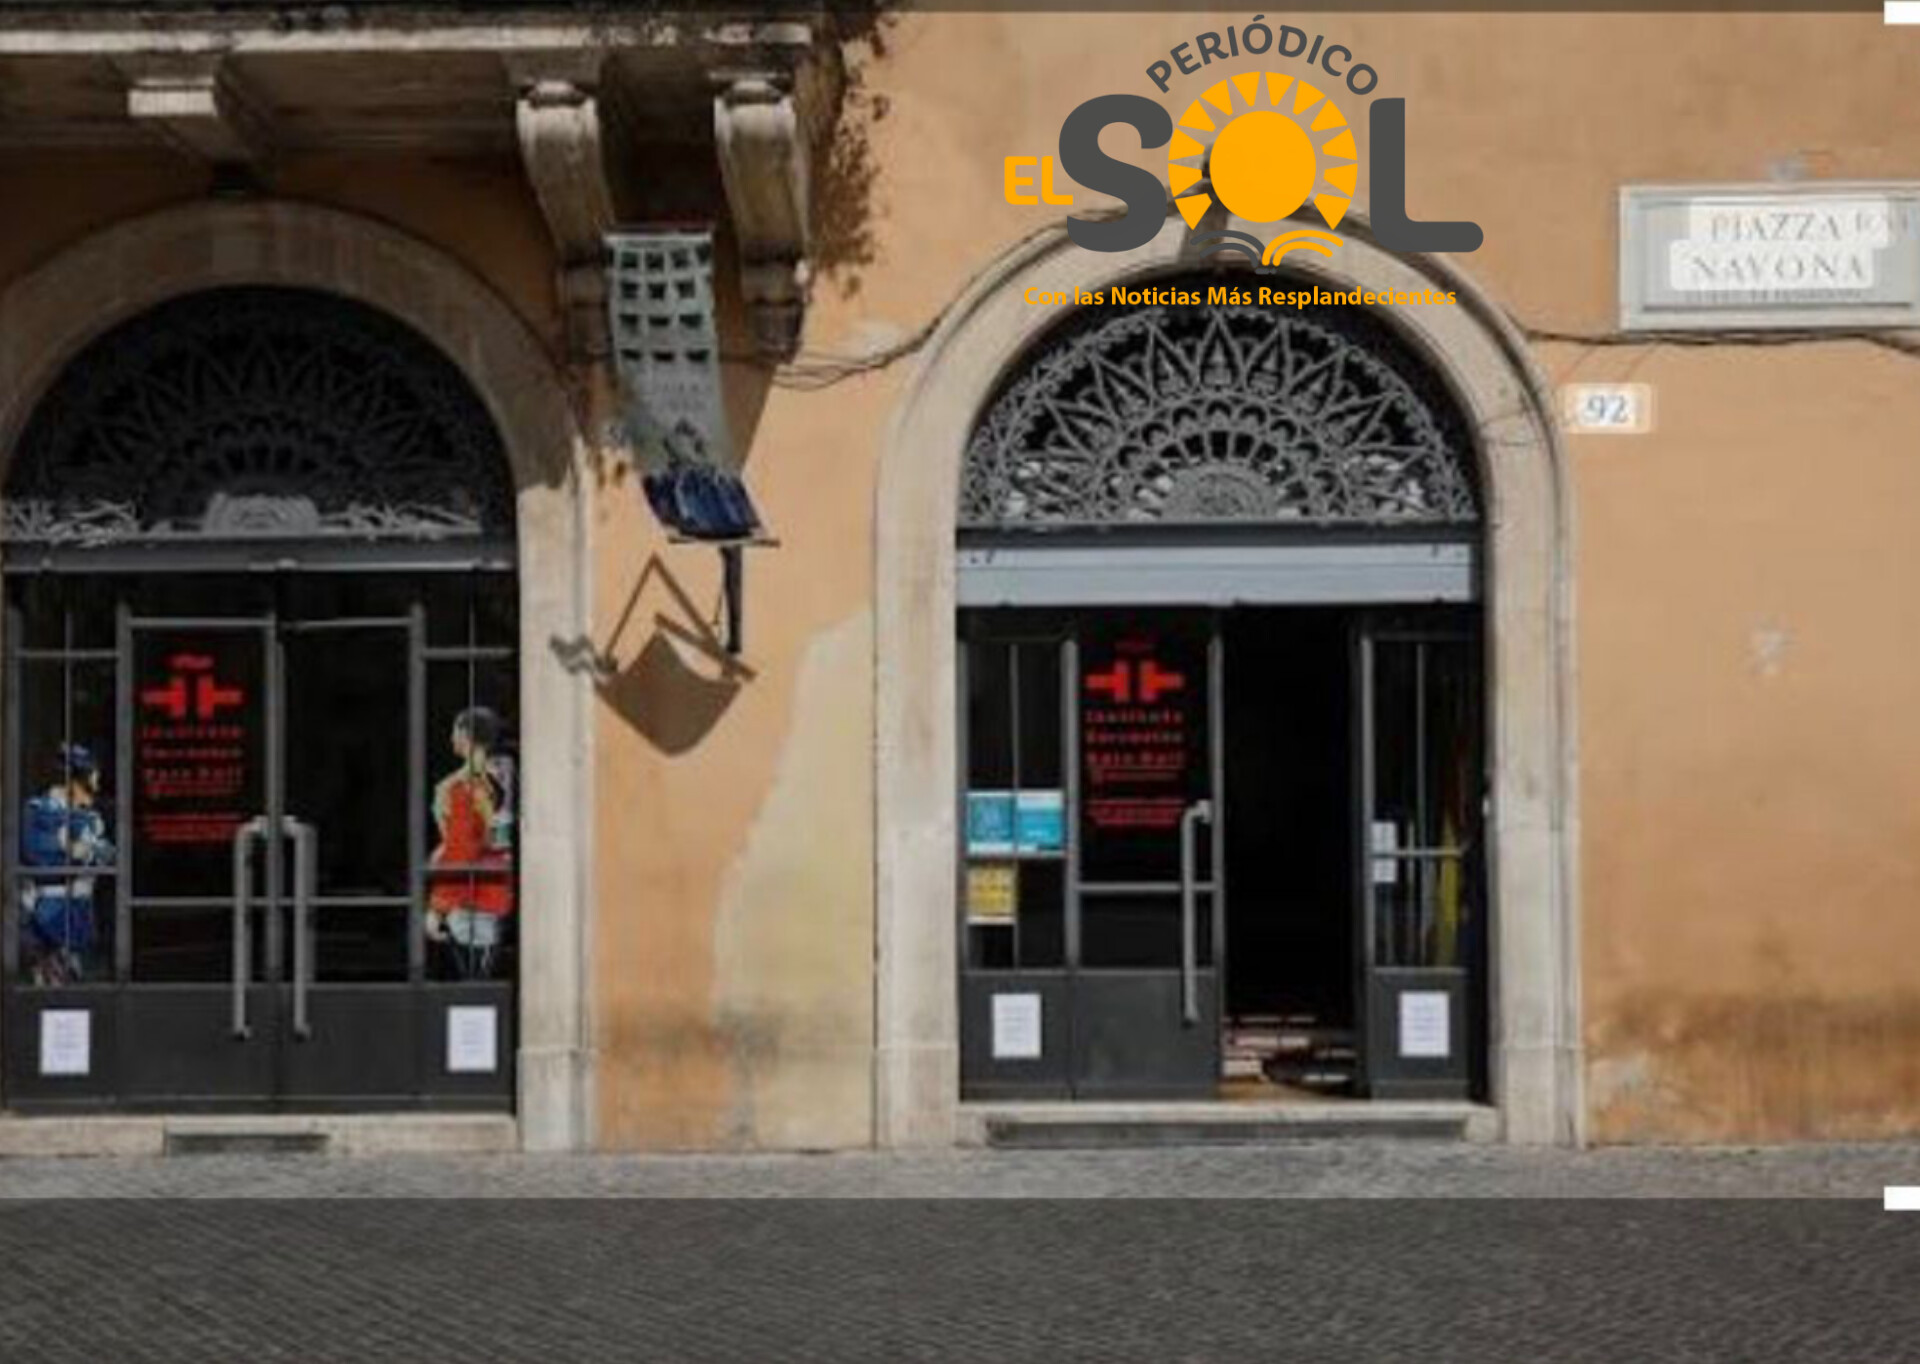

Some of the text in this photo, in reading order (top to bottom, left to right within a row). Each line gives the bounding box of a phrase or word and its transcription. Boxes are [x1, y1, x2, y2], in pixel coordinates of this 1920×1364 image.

[1709, 211, 1841, 241] PIAZZA
[1690, 254, 1864, 284] NAVONA
[1585, 395, 1630, 424] 92
